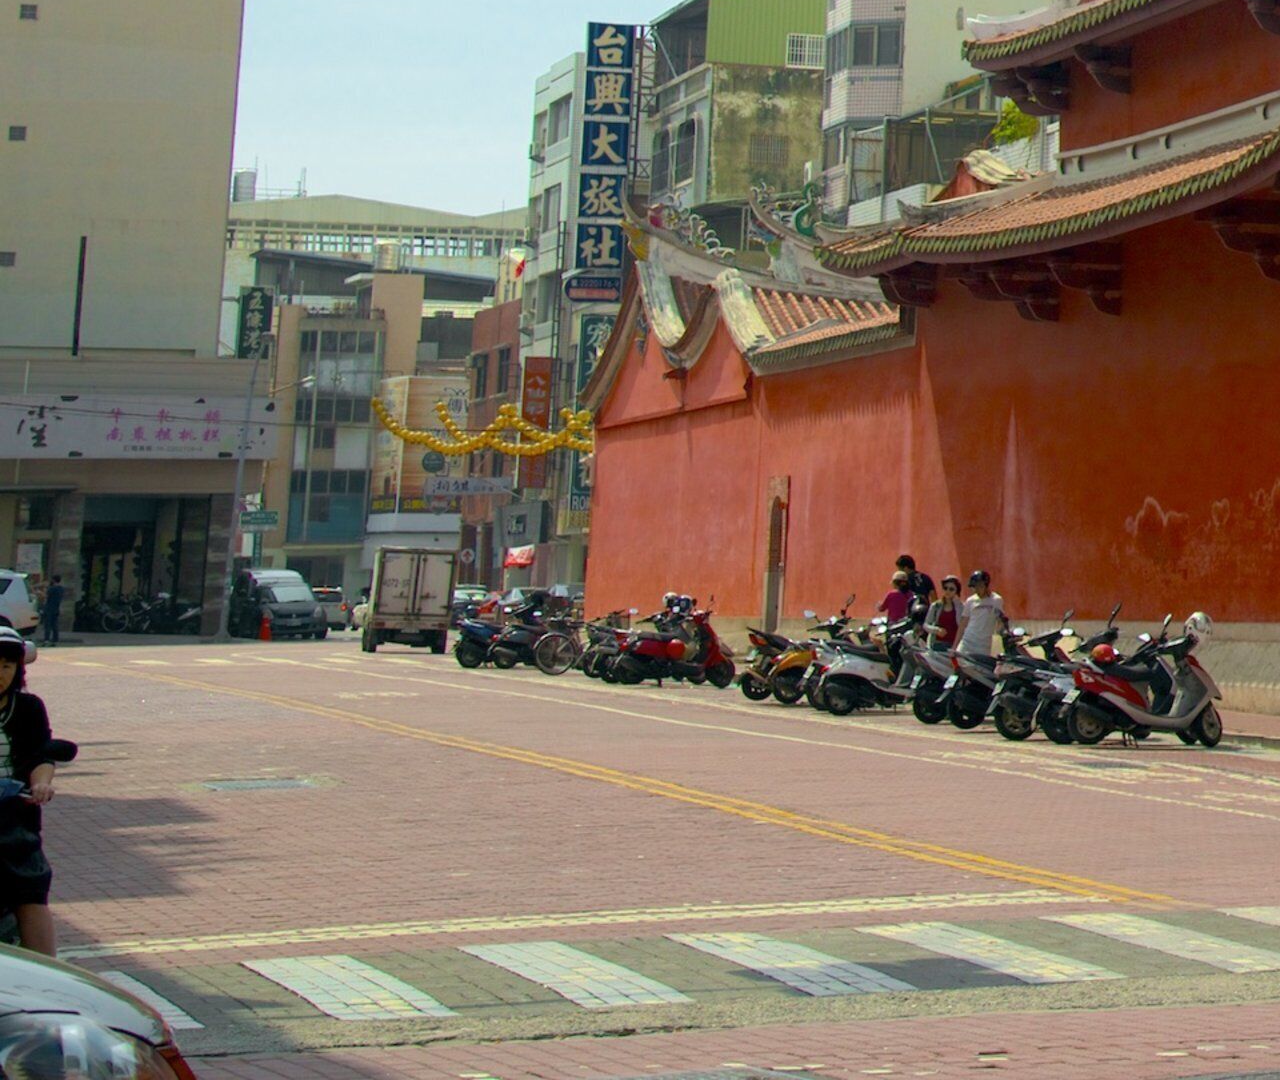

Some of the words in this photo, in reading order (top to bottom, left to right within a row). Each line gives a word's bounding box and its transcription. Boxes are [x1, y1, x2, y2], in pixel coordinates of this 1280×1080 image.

[580, 26, 629, 268] 台興大旅社
